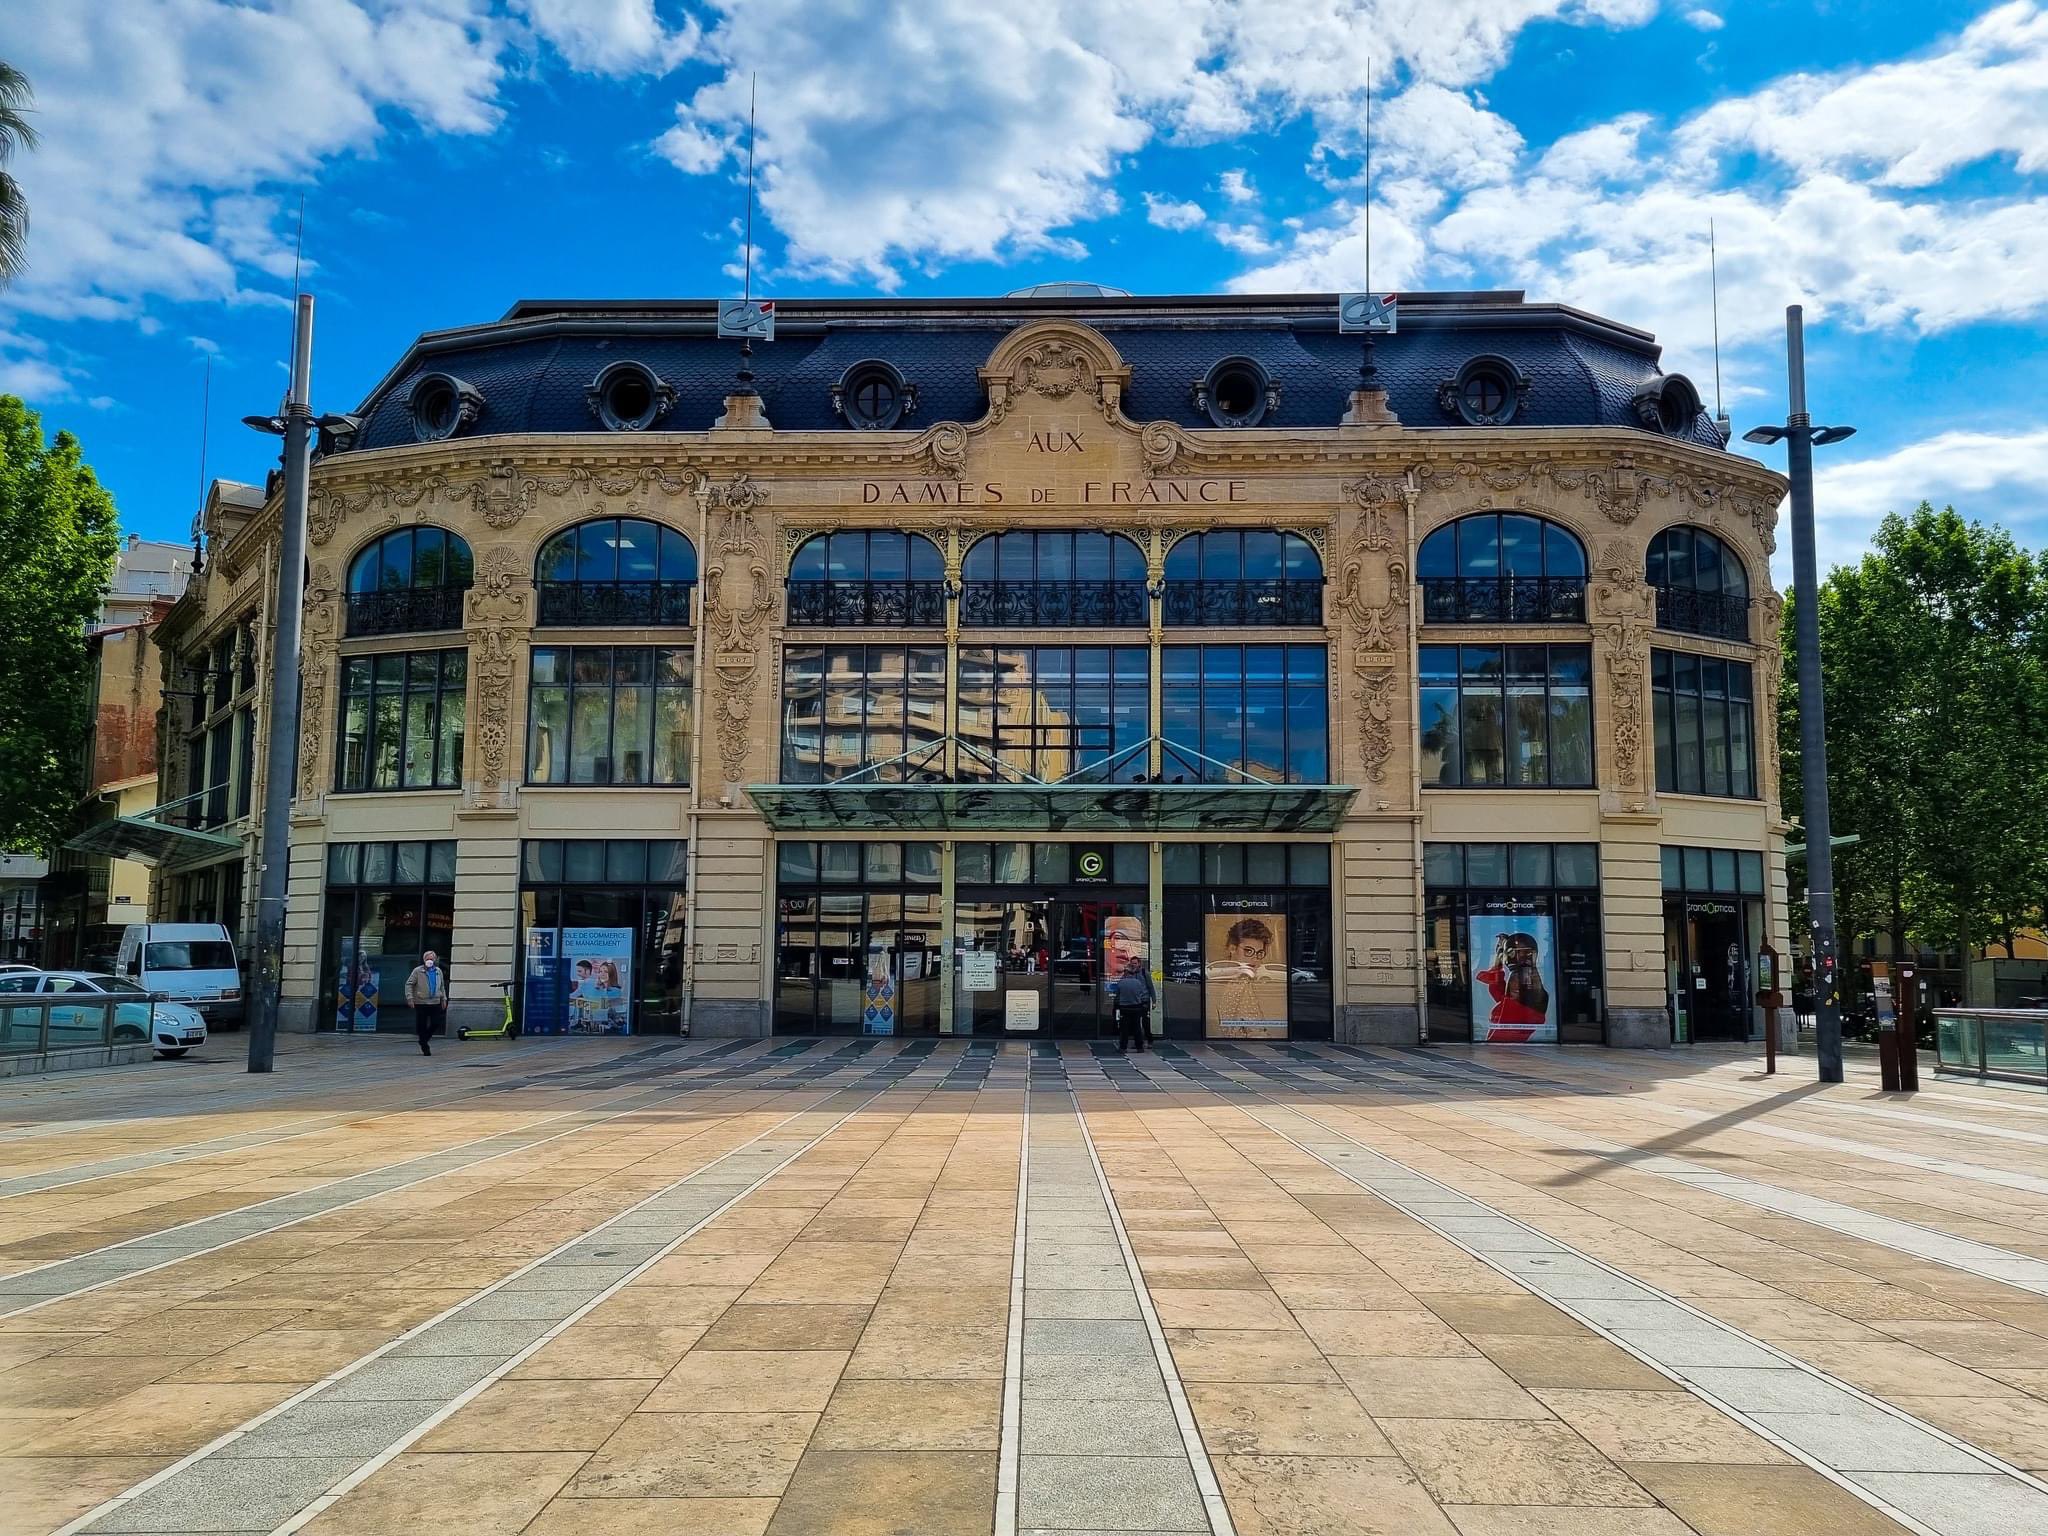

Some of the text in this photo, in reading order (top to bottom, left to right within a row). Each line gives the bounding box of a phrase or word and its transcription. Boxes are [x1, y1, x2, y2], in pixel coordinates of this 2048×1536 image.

[1026, 432, 1085, 453] AUX
[863, 482, 1248, 504] DAMES DE FRANCE
